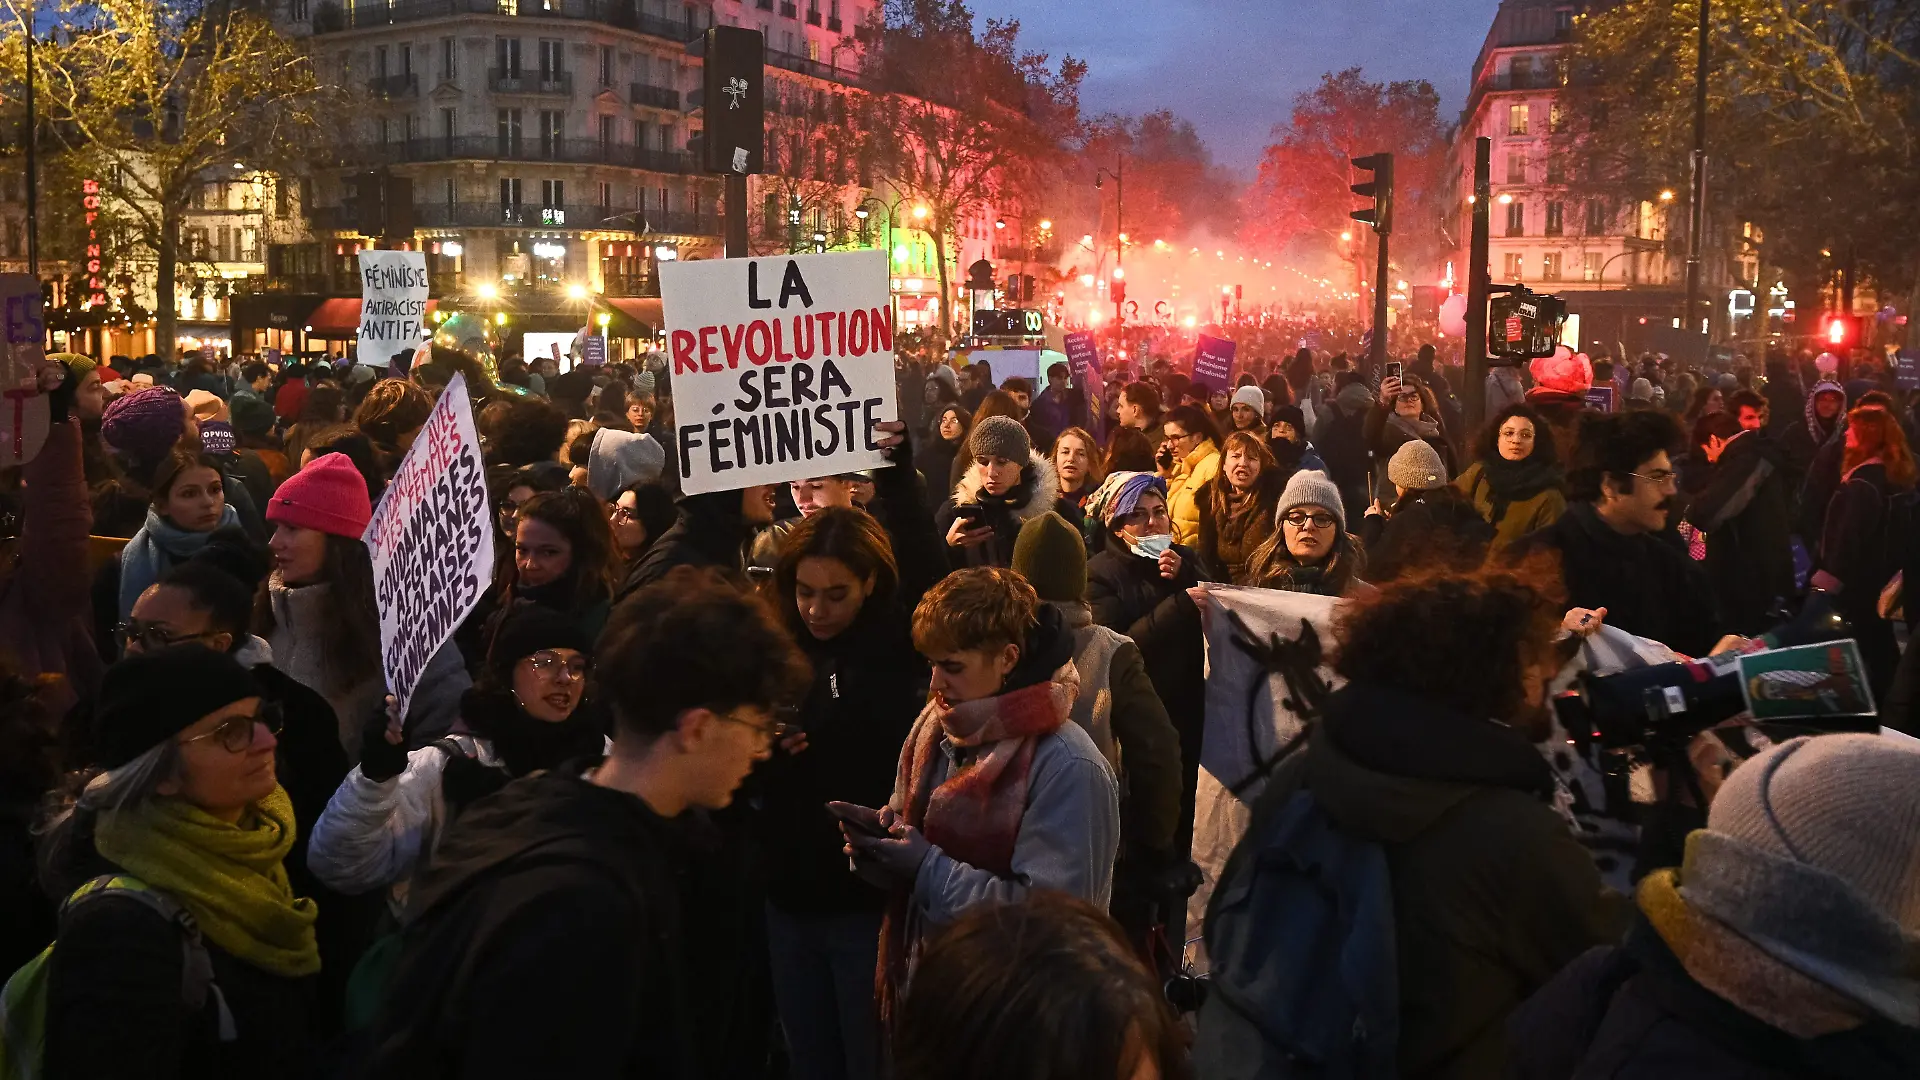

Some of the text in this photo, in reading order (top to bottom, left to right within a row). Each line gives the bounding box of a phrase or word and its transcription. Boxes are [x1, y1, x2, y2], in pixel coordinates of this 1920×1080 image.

[365, 264, 428, 290] FÉMINISME
[748, 260, 814, 309] LA
[361, 319, 422, 340] ANTIFA
[365, 299, 427, 316] ANTIRACISTE
[671, 304, 893, 376] REVOLUTION
[1197, 358, 1228, 372] féminisme
[1201, 351, 1216, 360] Pour
[734, 359, 852, 412] SERA
[1195, 367, 1227, 380] décolonial
[428, 391, 456, 452] AVEC
[679, 397, 884, 479] FÉMINISTE
[386, 422, 462, 558] LES FEMMES
[379, 444, 475, 621] SOUDANAISES
[396, 471, 485, 625] AFGHANES
[387, 517, 482, 679] CONGOLAISES
[394, 560, 479, 708] IRANIENNES
